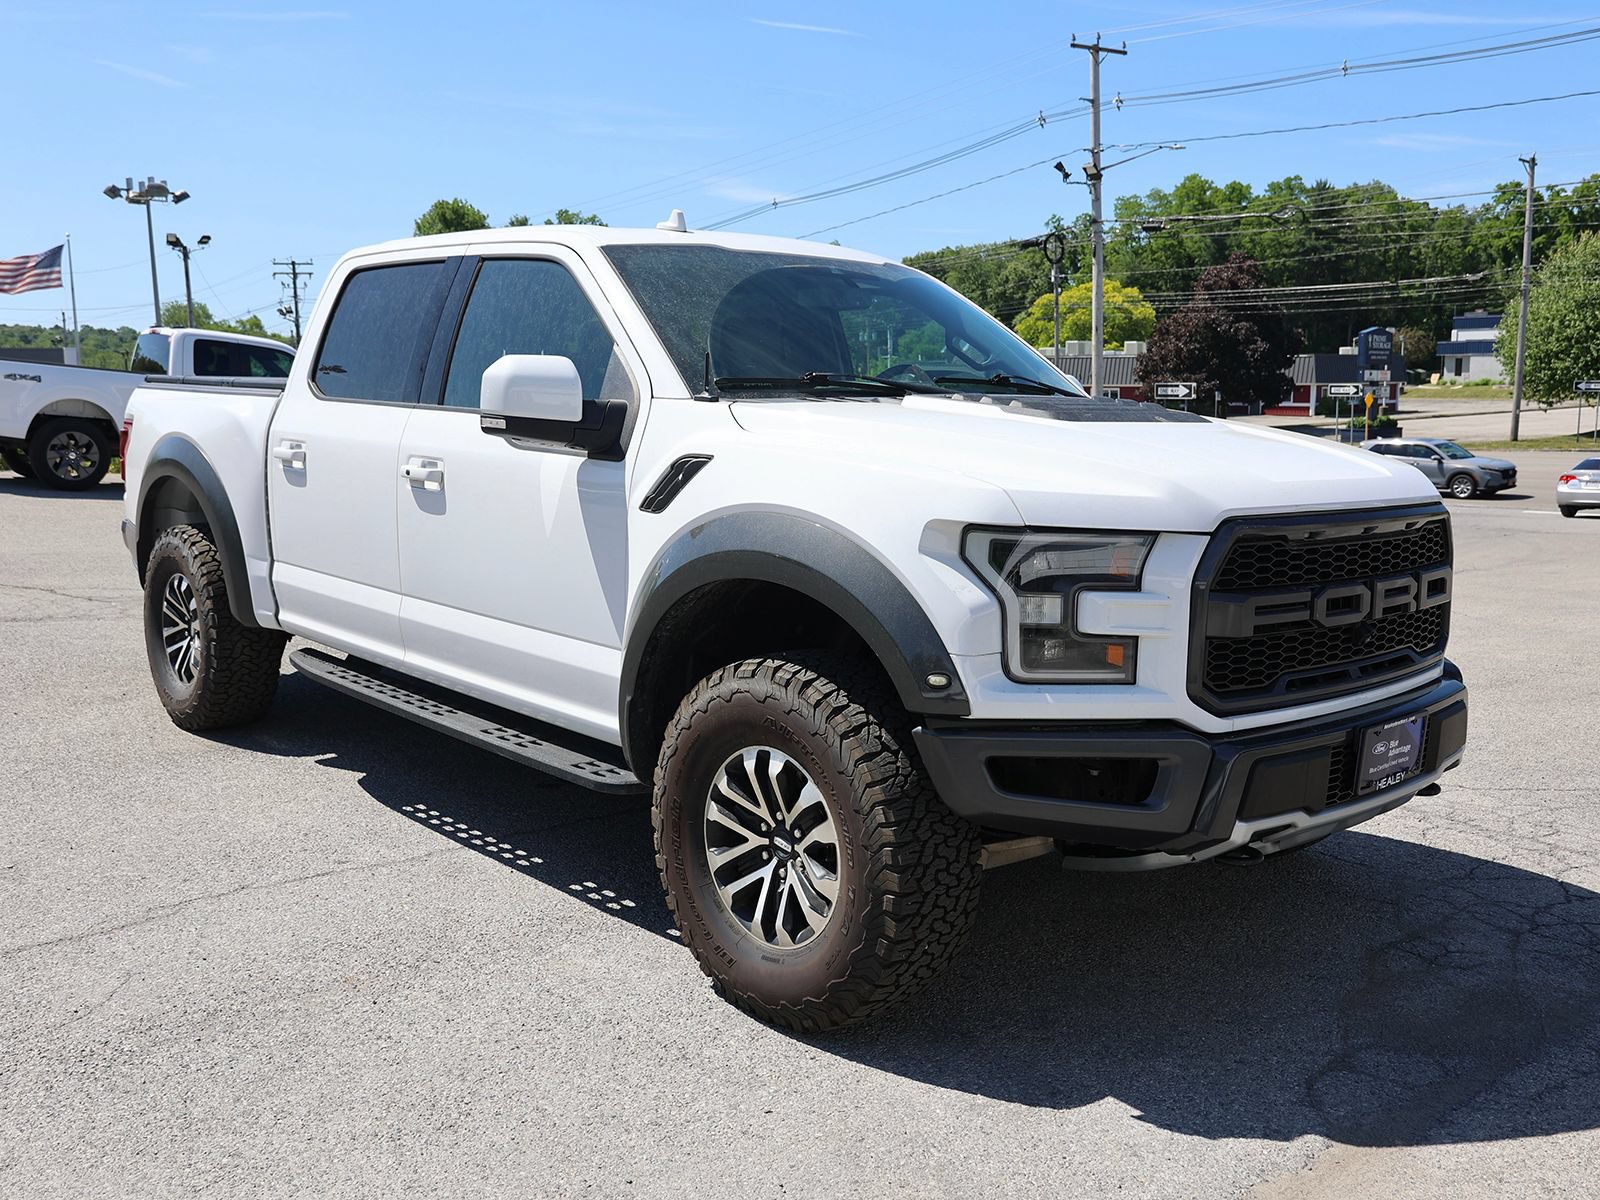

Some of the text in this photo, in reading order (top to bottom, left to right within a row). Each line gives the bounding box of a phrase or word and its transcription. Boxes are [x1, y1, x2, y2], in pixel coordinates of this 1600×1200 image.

[1248, 566, 1452, 636] FORD
[1388, 745, 1411, 757] Advantage
[1376, 771, 1406, 790] HEALEY
